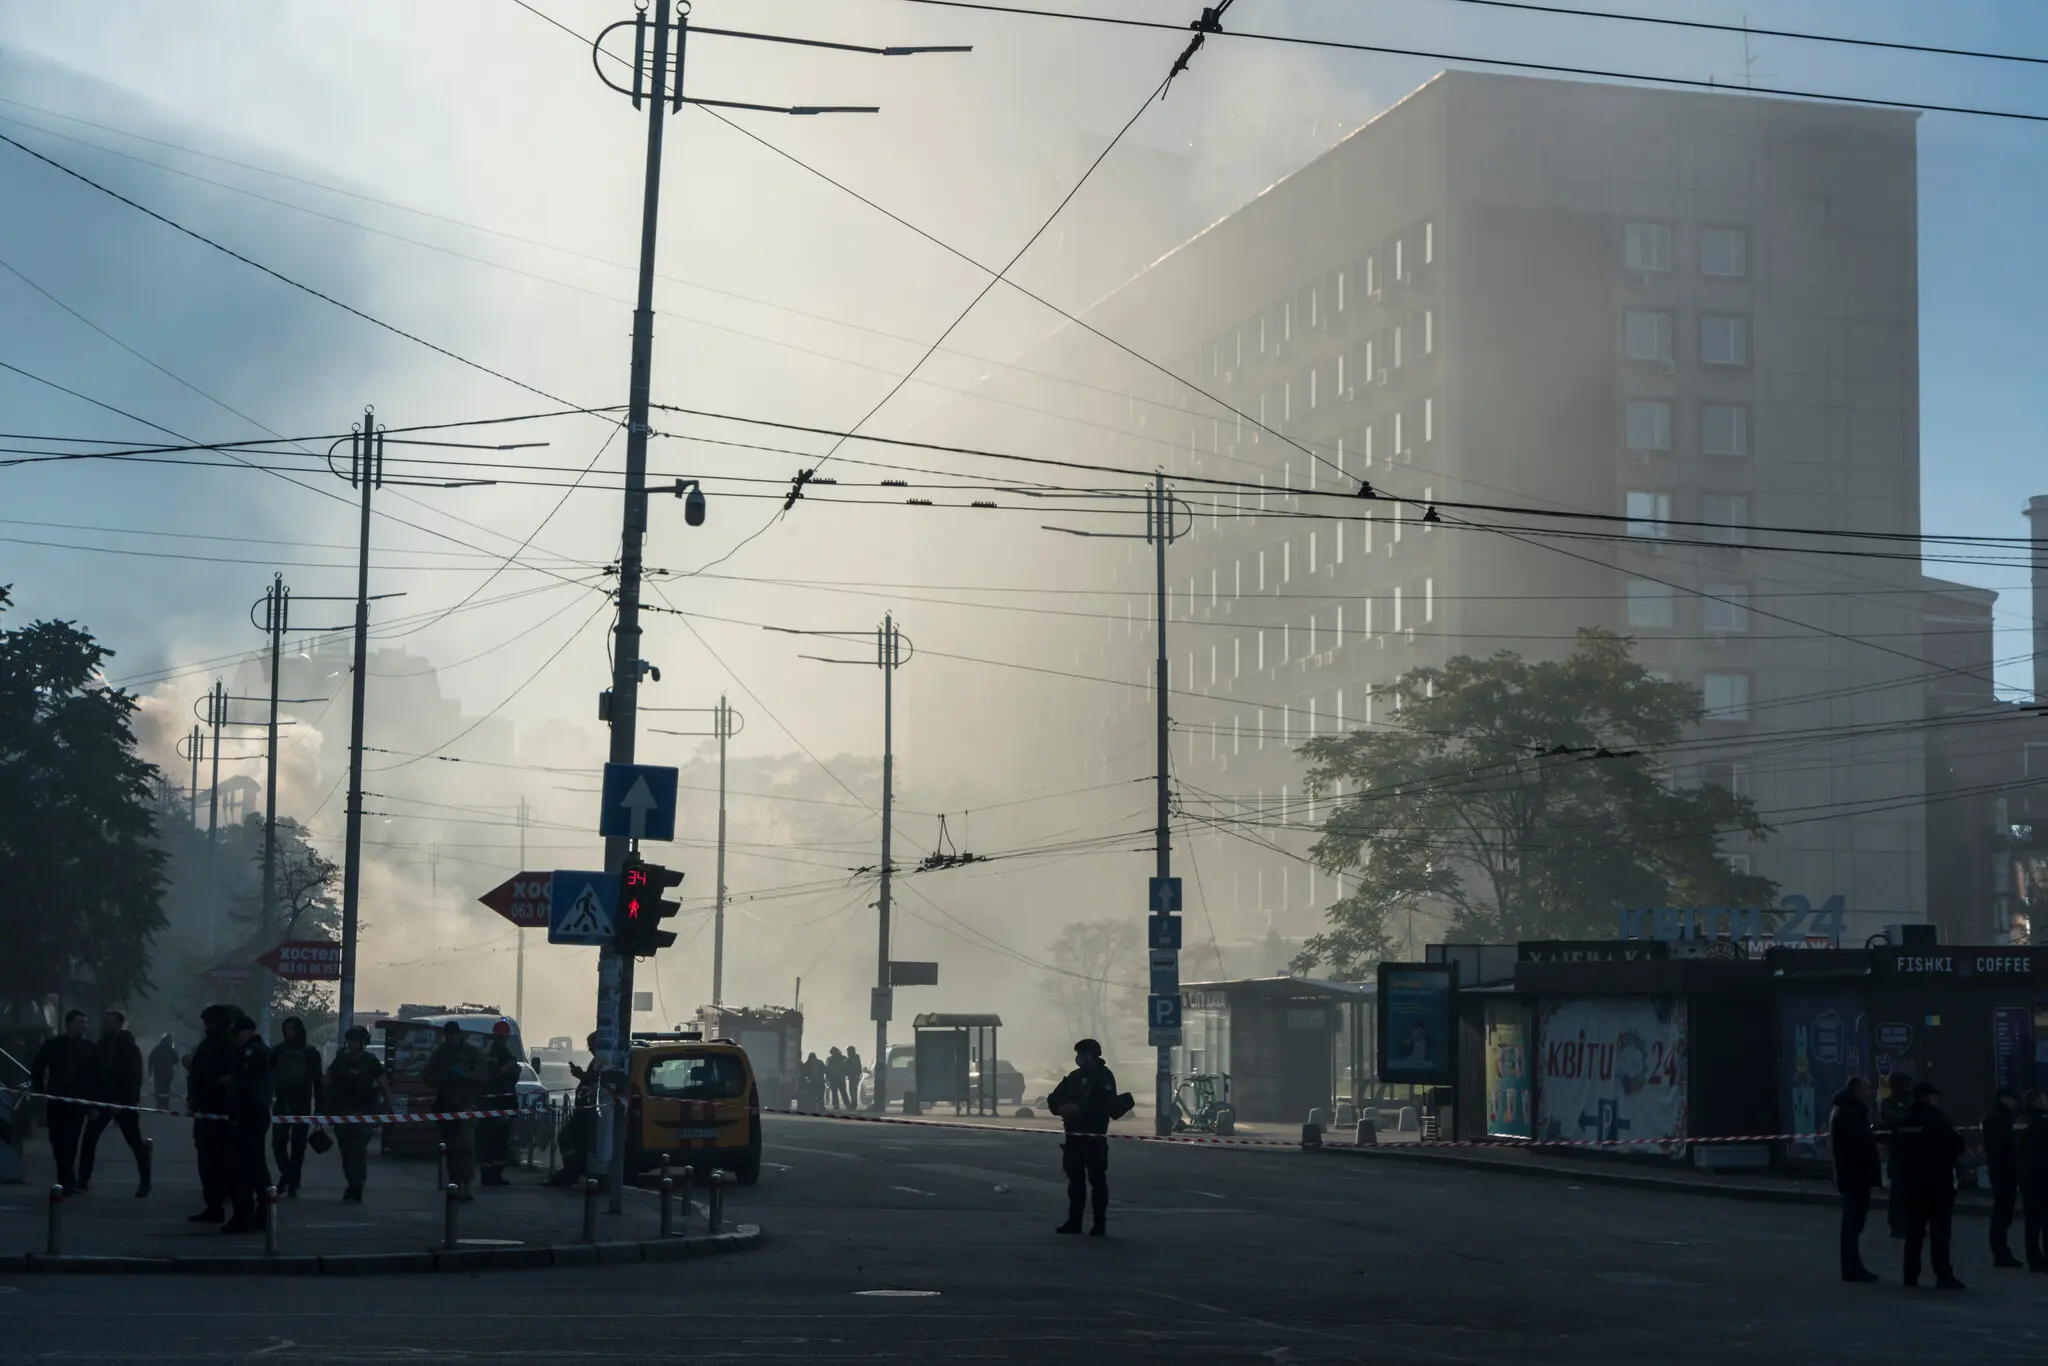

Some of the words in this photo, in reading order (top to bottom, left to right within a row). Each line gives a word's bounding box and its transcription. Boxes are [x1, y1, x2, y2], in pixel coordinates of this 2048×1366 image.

[627, 869, 647, 886] 34
[511, 903, 534, 918] 063
[1775, 894, 1847, 939] 24
[1897, 956, 1953, 973] FISHKI
[1976, 956, 2031, 973] COFFEE
[1156, 1000, 1174, 1024] P
[1648, 1041, 1677, 1086] 24
